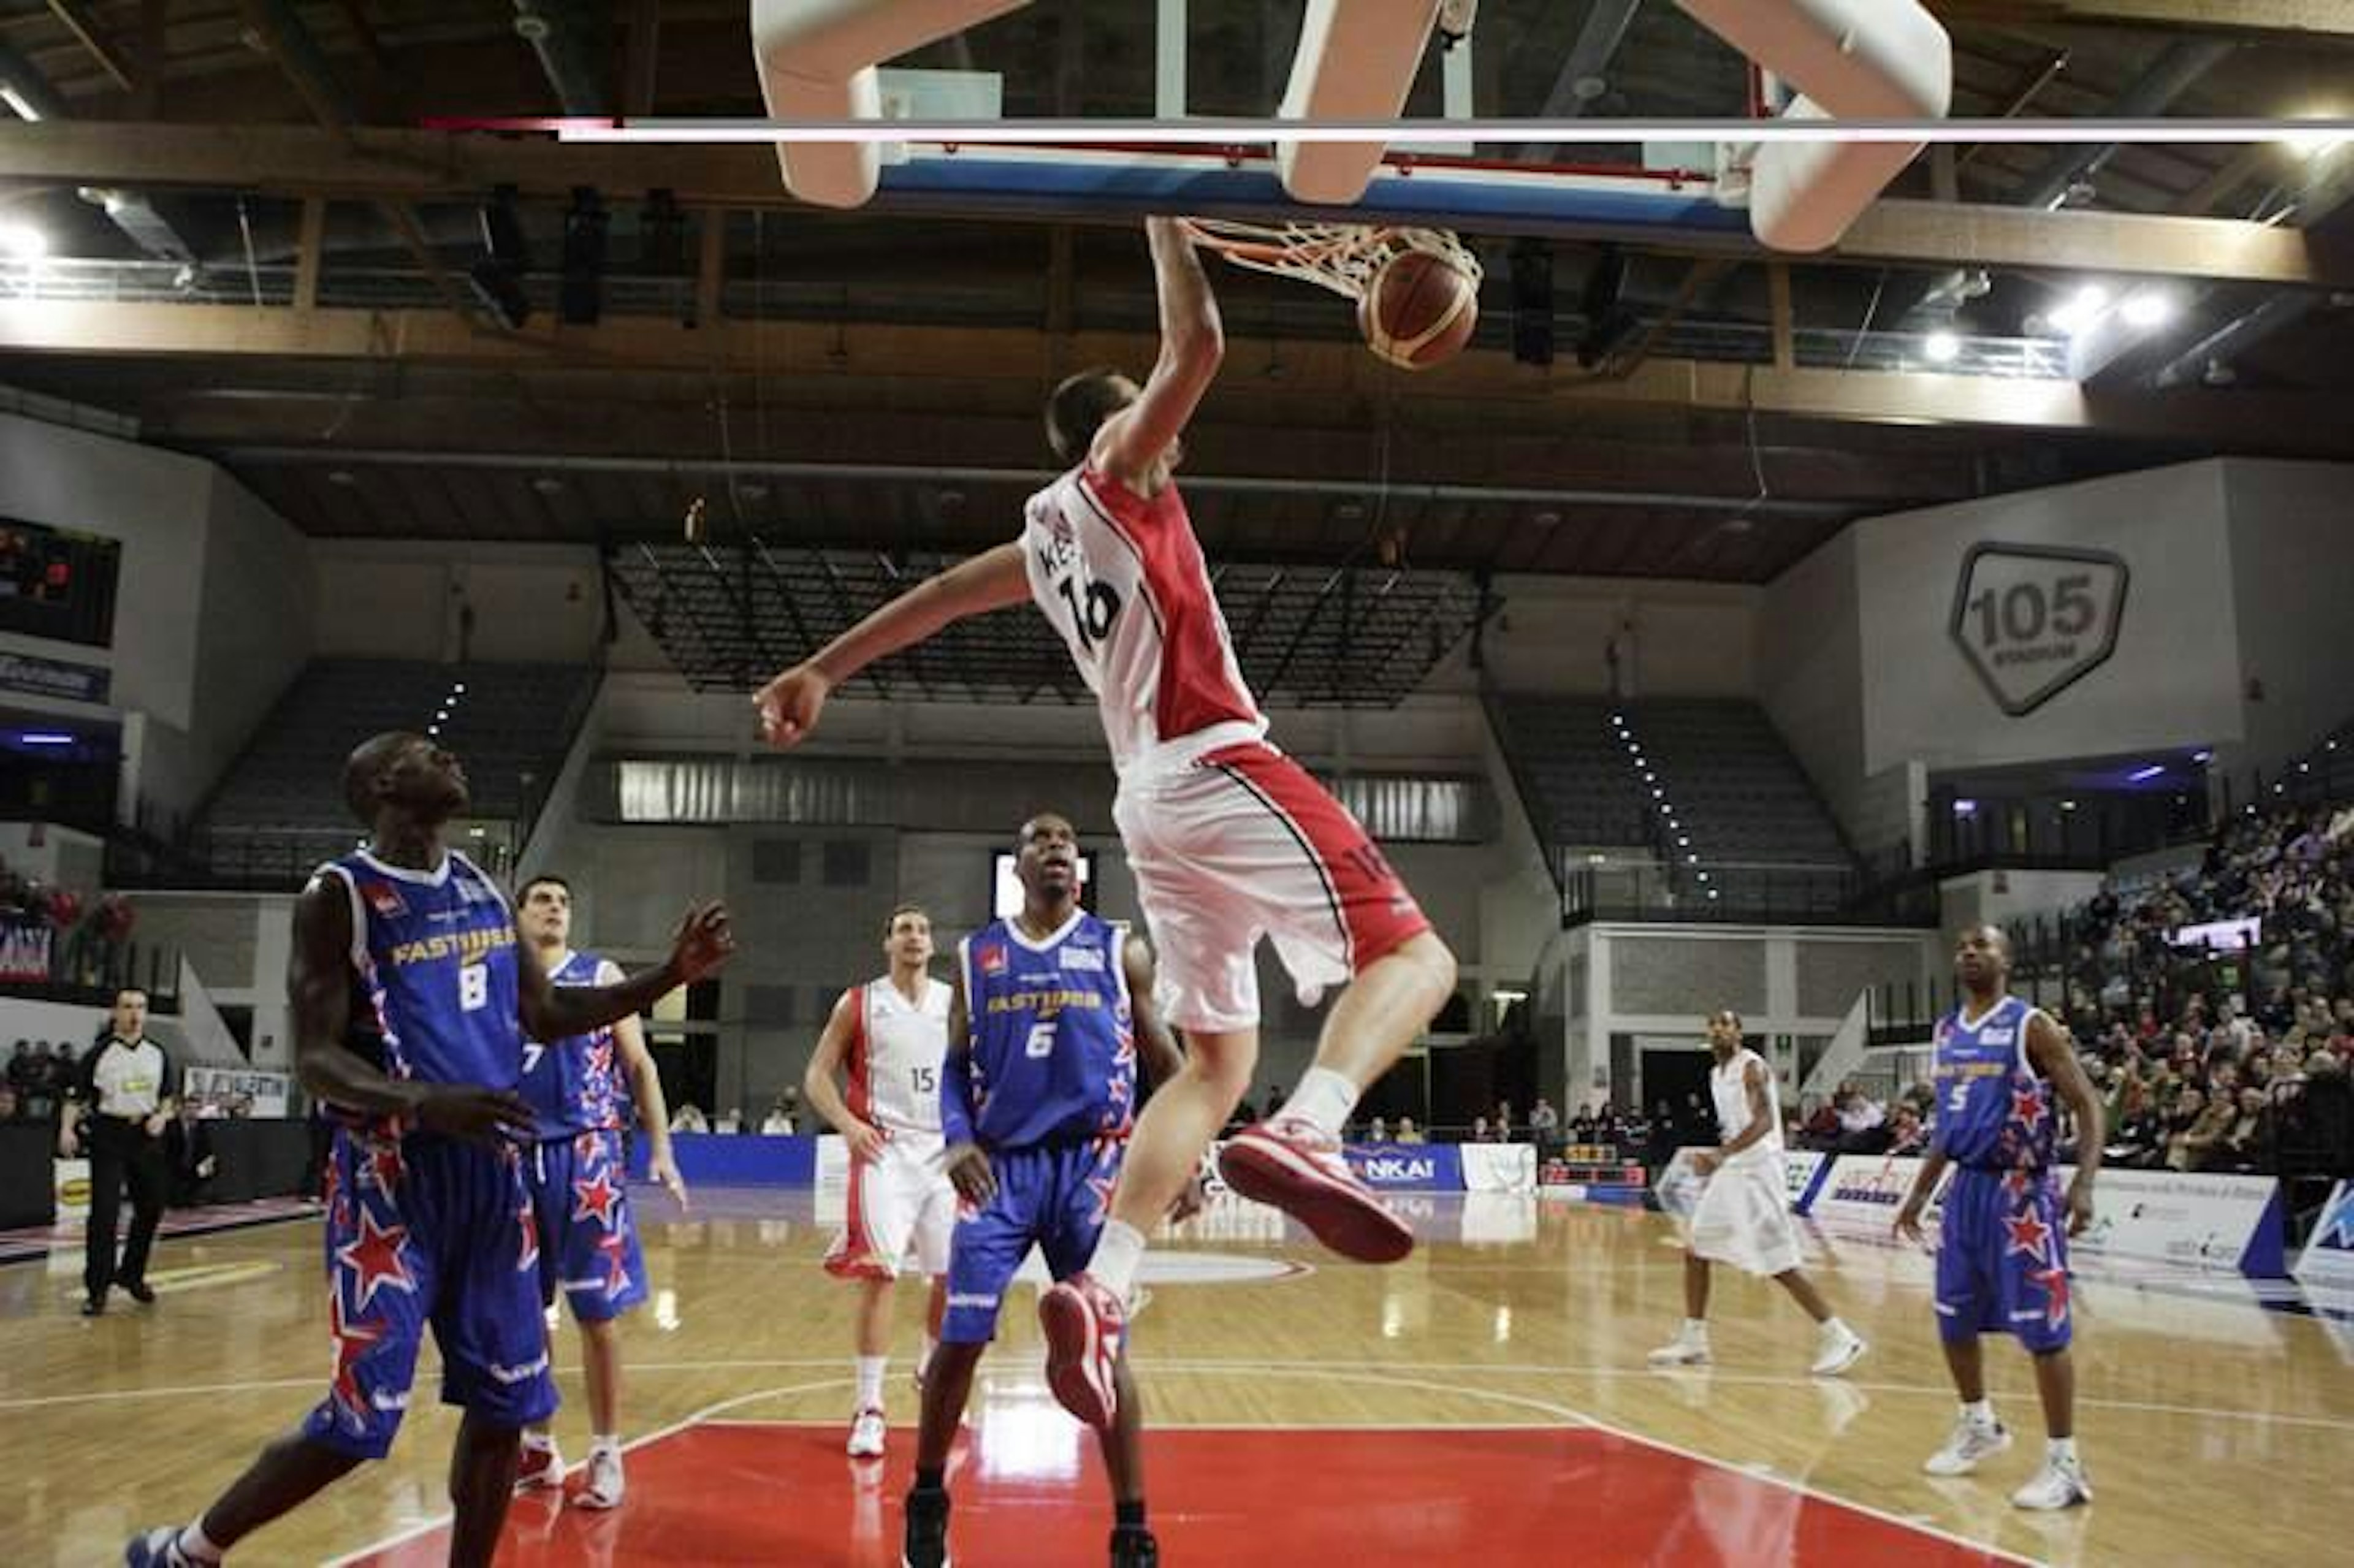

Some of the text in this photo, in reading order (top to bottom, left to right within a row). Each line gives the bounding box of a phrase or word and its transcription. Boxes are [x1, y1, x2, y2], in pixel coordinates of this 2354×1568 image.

[1971, 576, 2095, 647] 105
[459, 964, 487, 1011] 8
[1026, 1022, 1059, 1059] 6
[522, 1043, 544, 1073] 7
[911, 1067, 934, 1094] 15
[1946, 1083, 1970, 1110] 5
